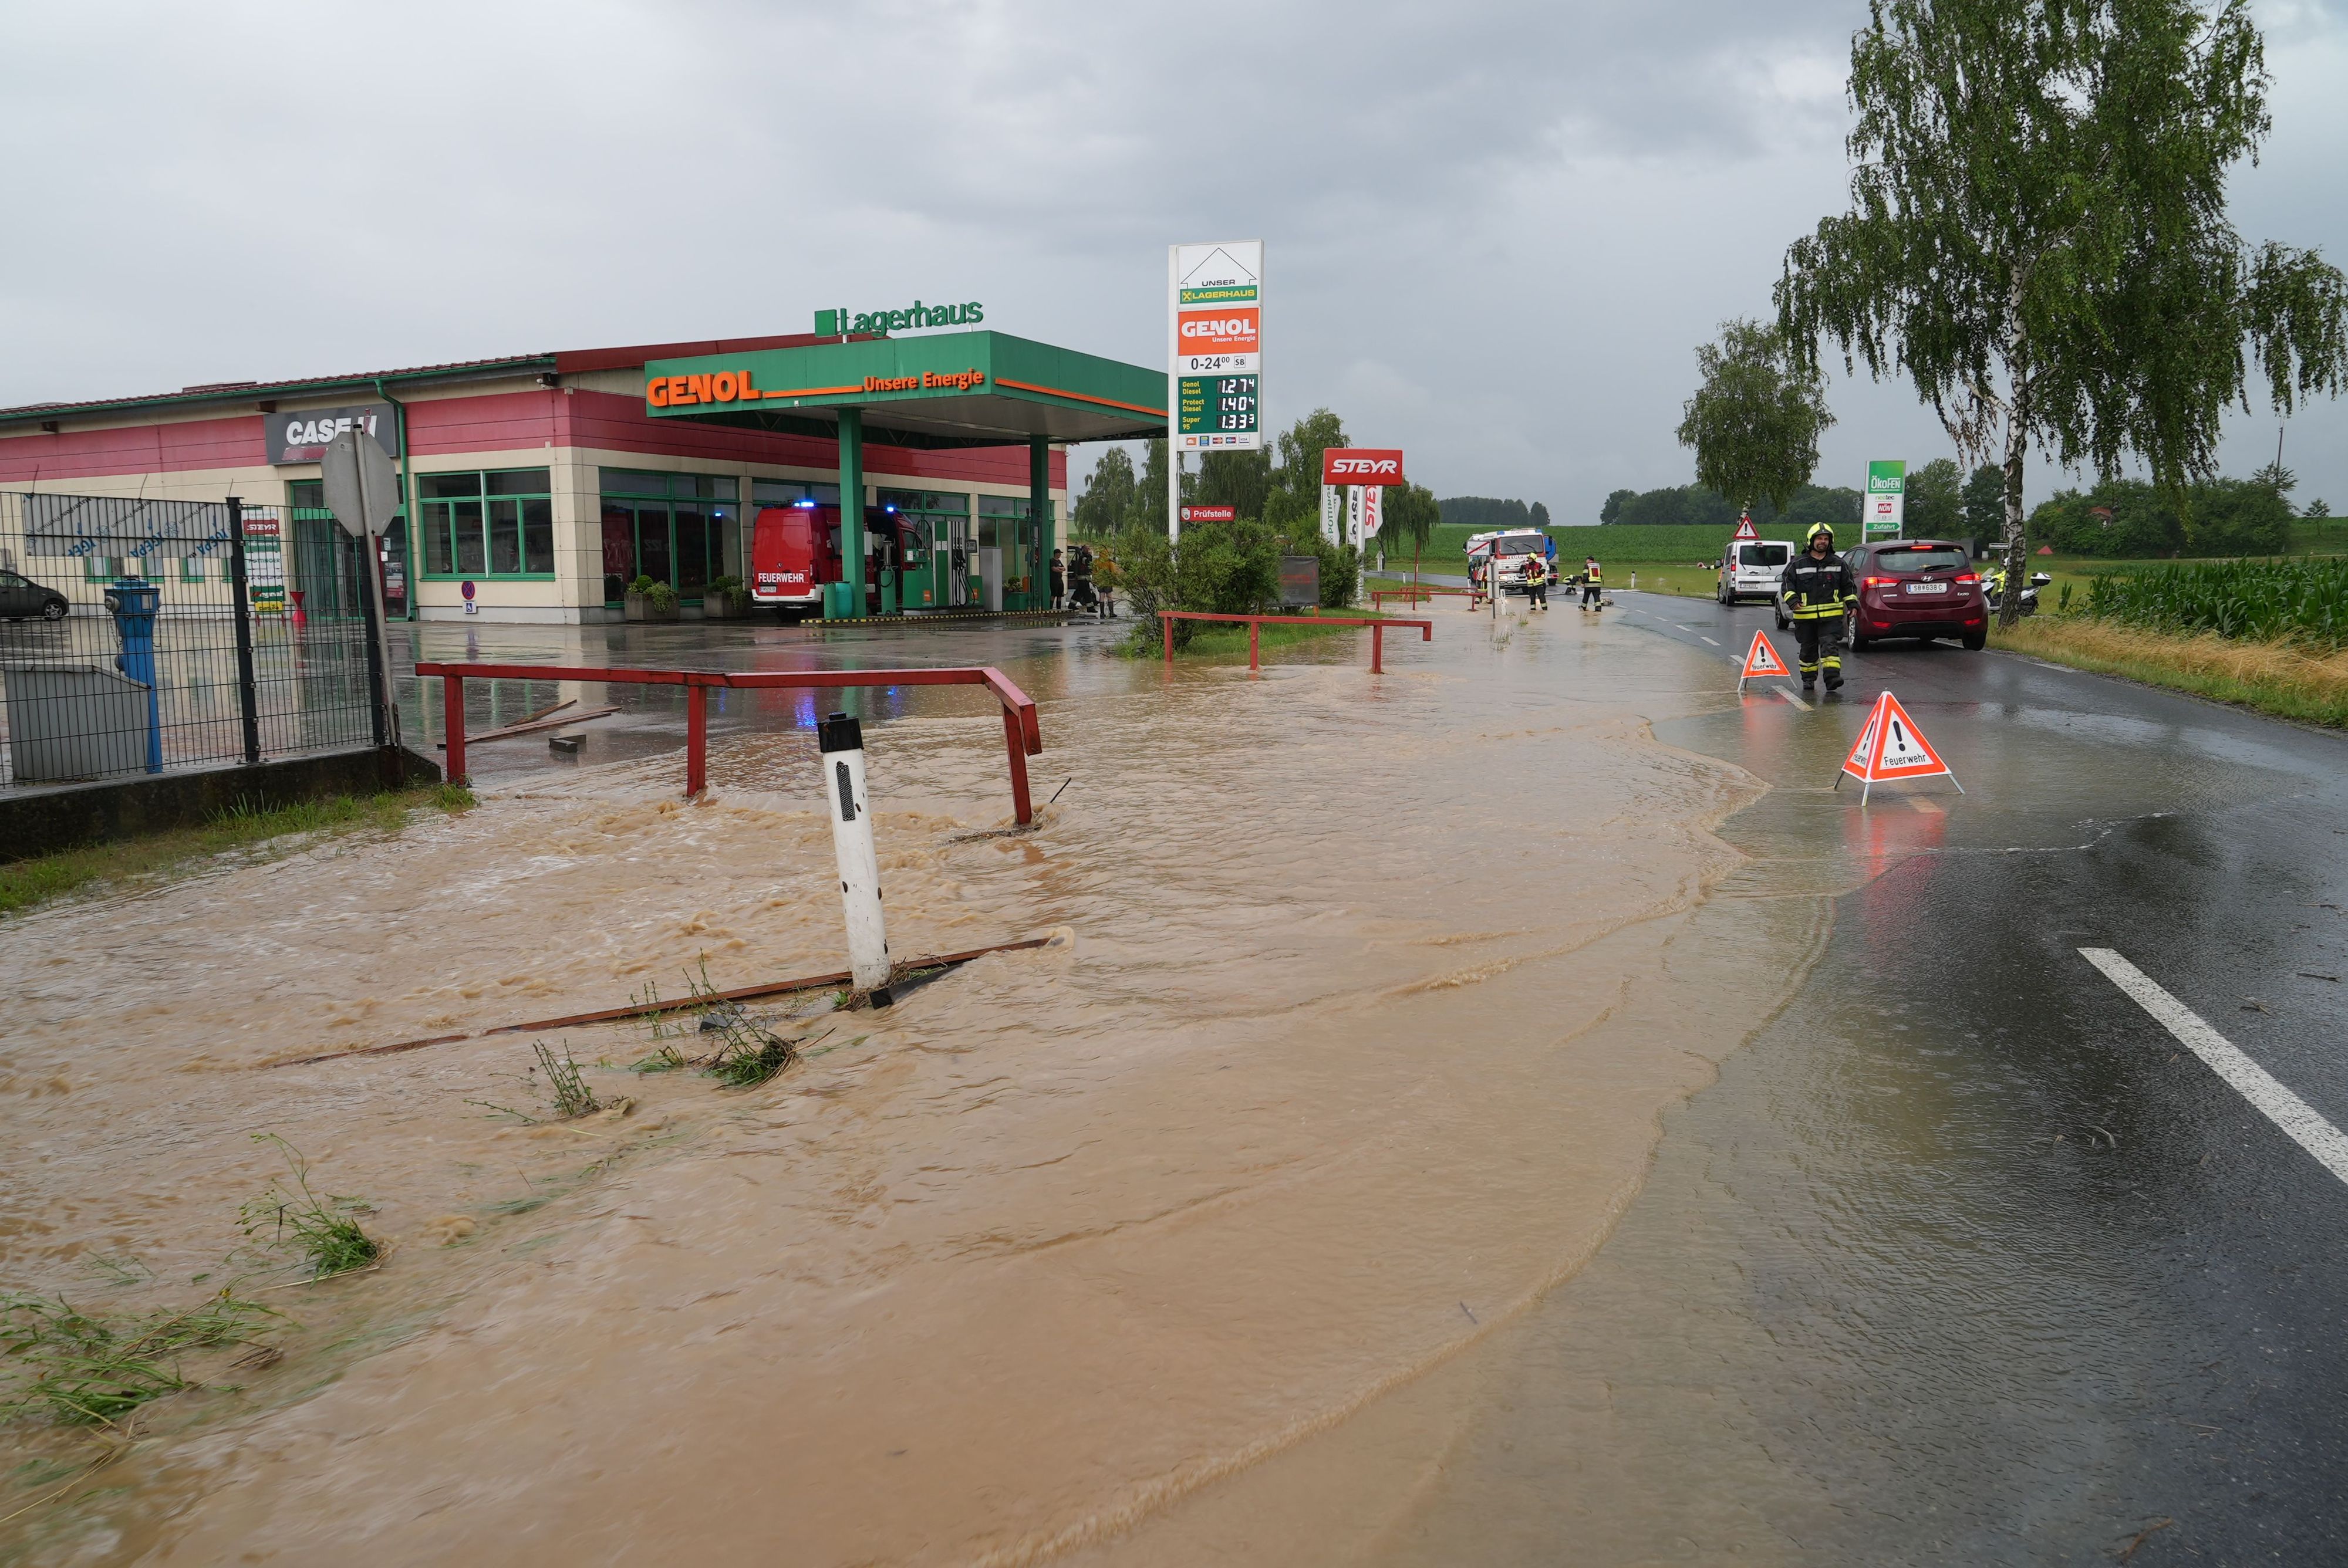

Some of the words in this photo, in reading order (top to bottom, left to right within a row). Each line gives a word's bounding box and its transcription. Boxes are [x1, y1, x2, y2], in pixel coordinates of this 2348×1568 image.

[1192, 289, 1255, 299] LAGERHAUS
[839, 300, 983, 337] Lagerhaus
[1181, 319, 1256, 337] GENOL
[646, 369, 763, 407] GENOL
[863, 376, 919, 393] Unsere
[923, 367, 984, 390] Energie
[286, 417, 352, 445] CASE
[1330, 459, 1397, 474] STEYR
[1193, 509, 1232, 518] Prüfstelle
[758, 573, 804, 583] FEUERWEHR
[1884, 753, 1926, 766] Feuerwehr
